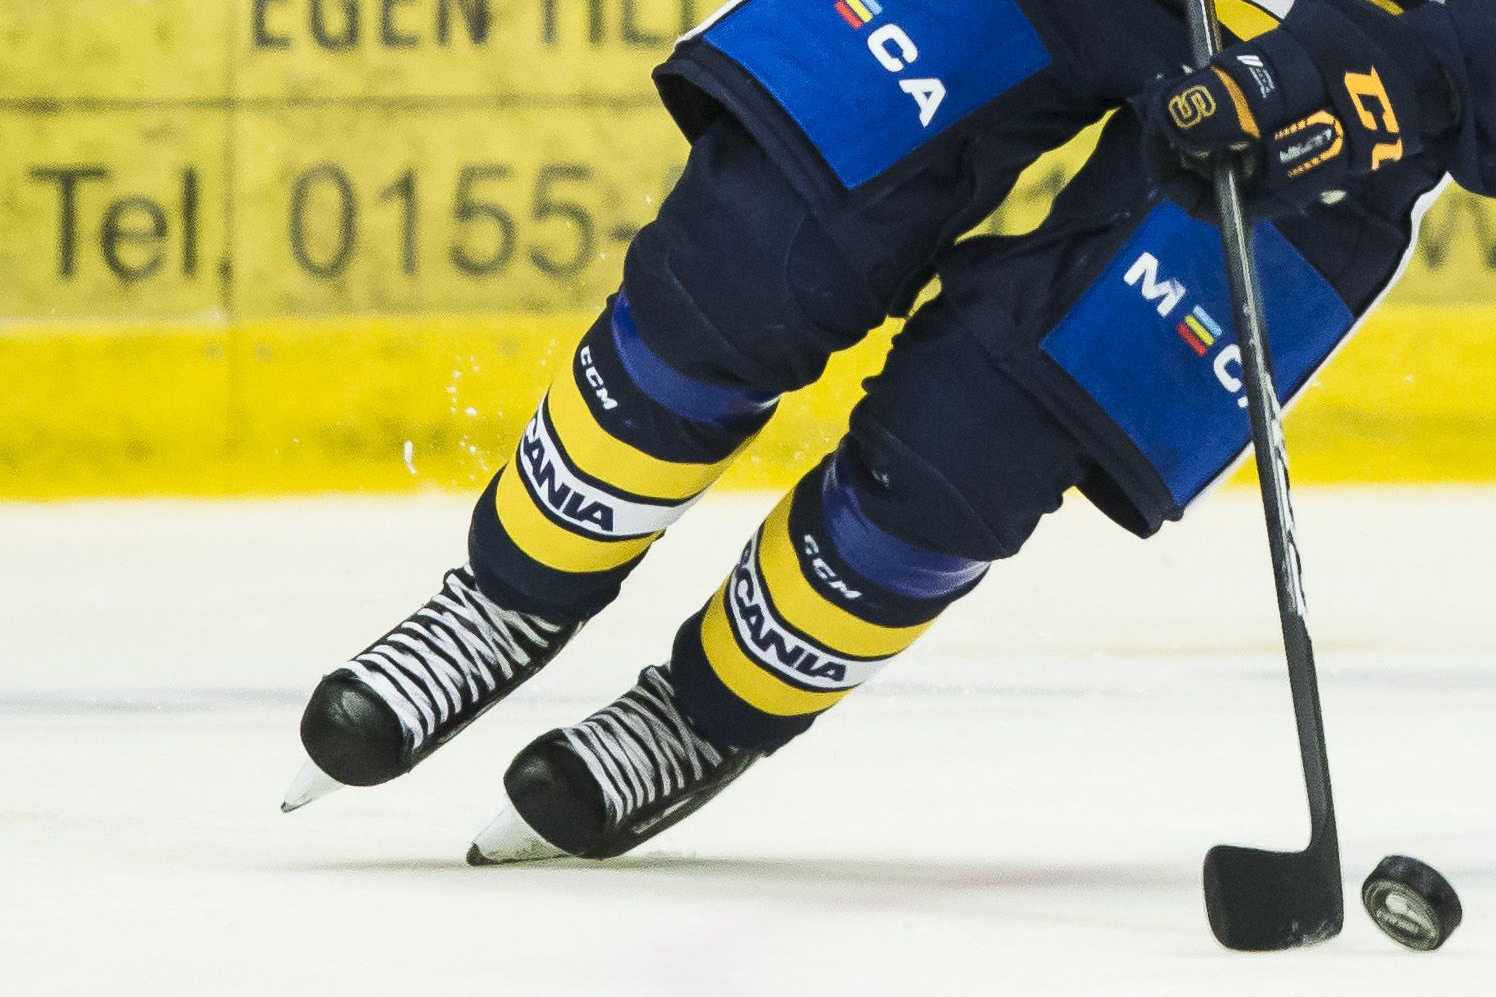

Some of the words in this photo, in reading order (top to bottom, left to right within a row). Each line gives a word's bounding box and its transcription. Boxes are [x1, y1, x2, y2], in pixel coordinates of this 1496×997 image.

[1123, 251, 1249, 408] MEC
[580, 345, 618, 410] CCM
[804, 534, 863, 599] CCM
